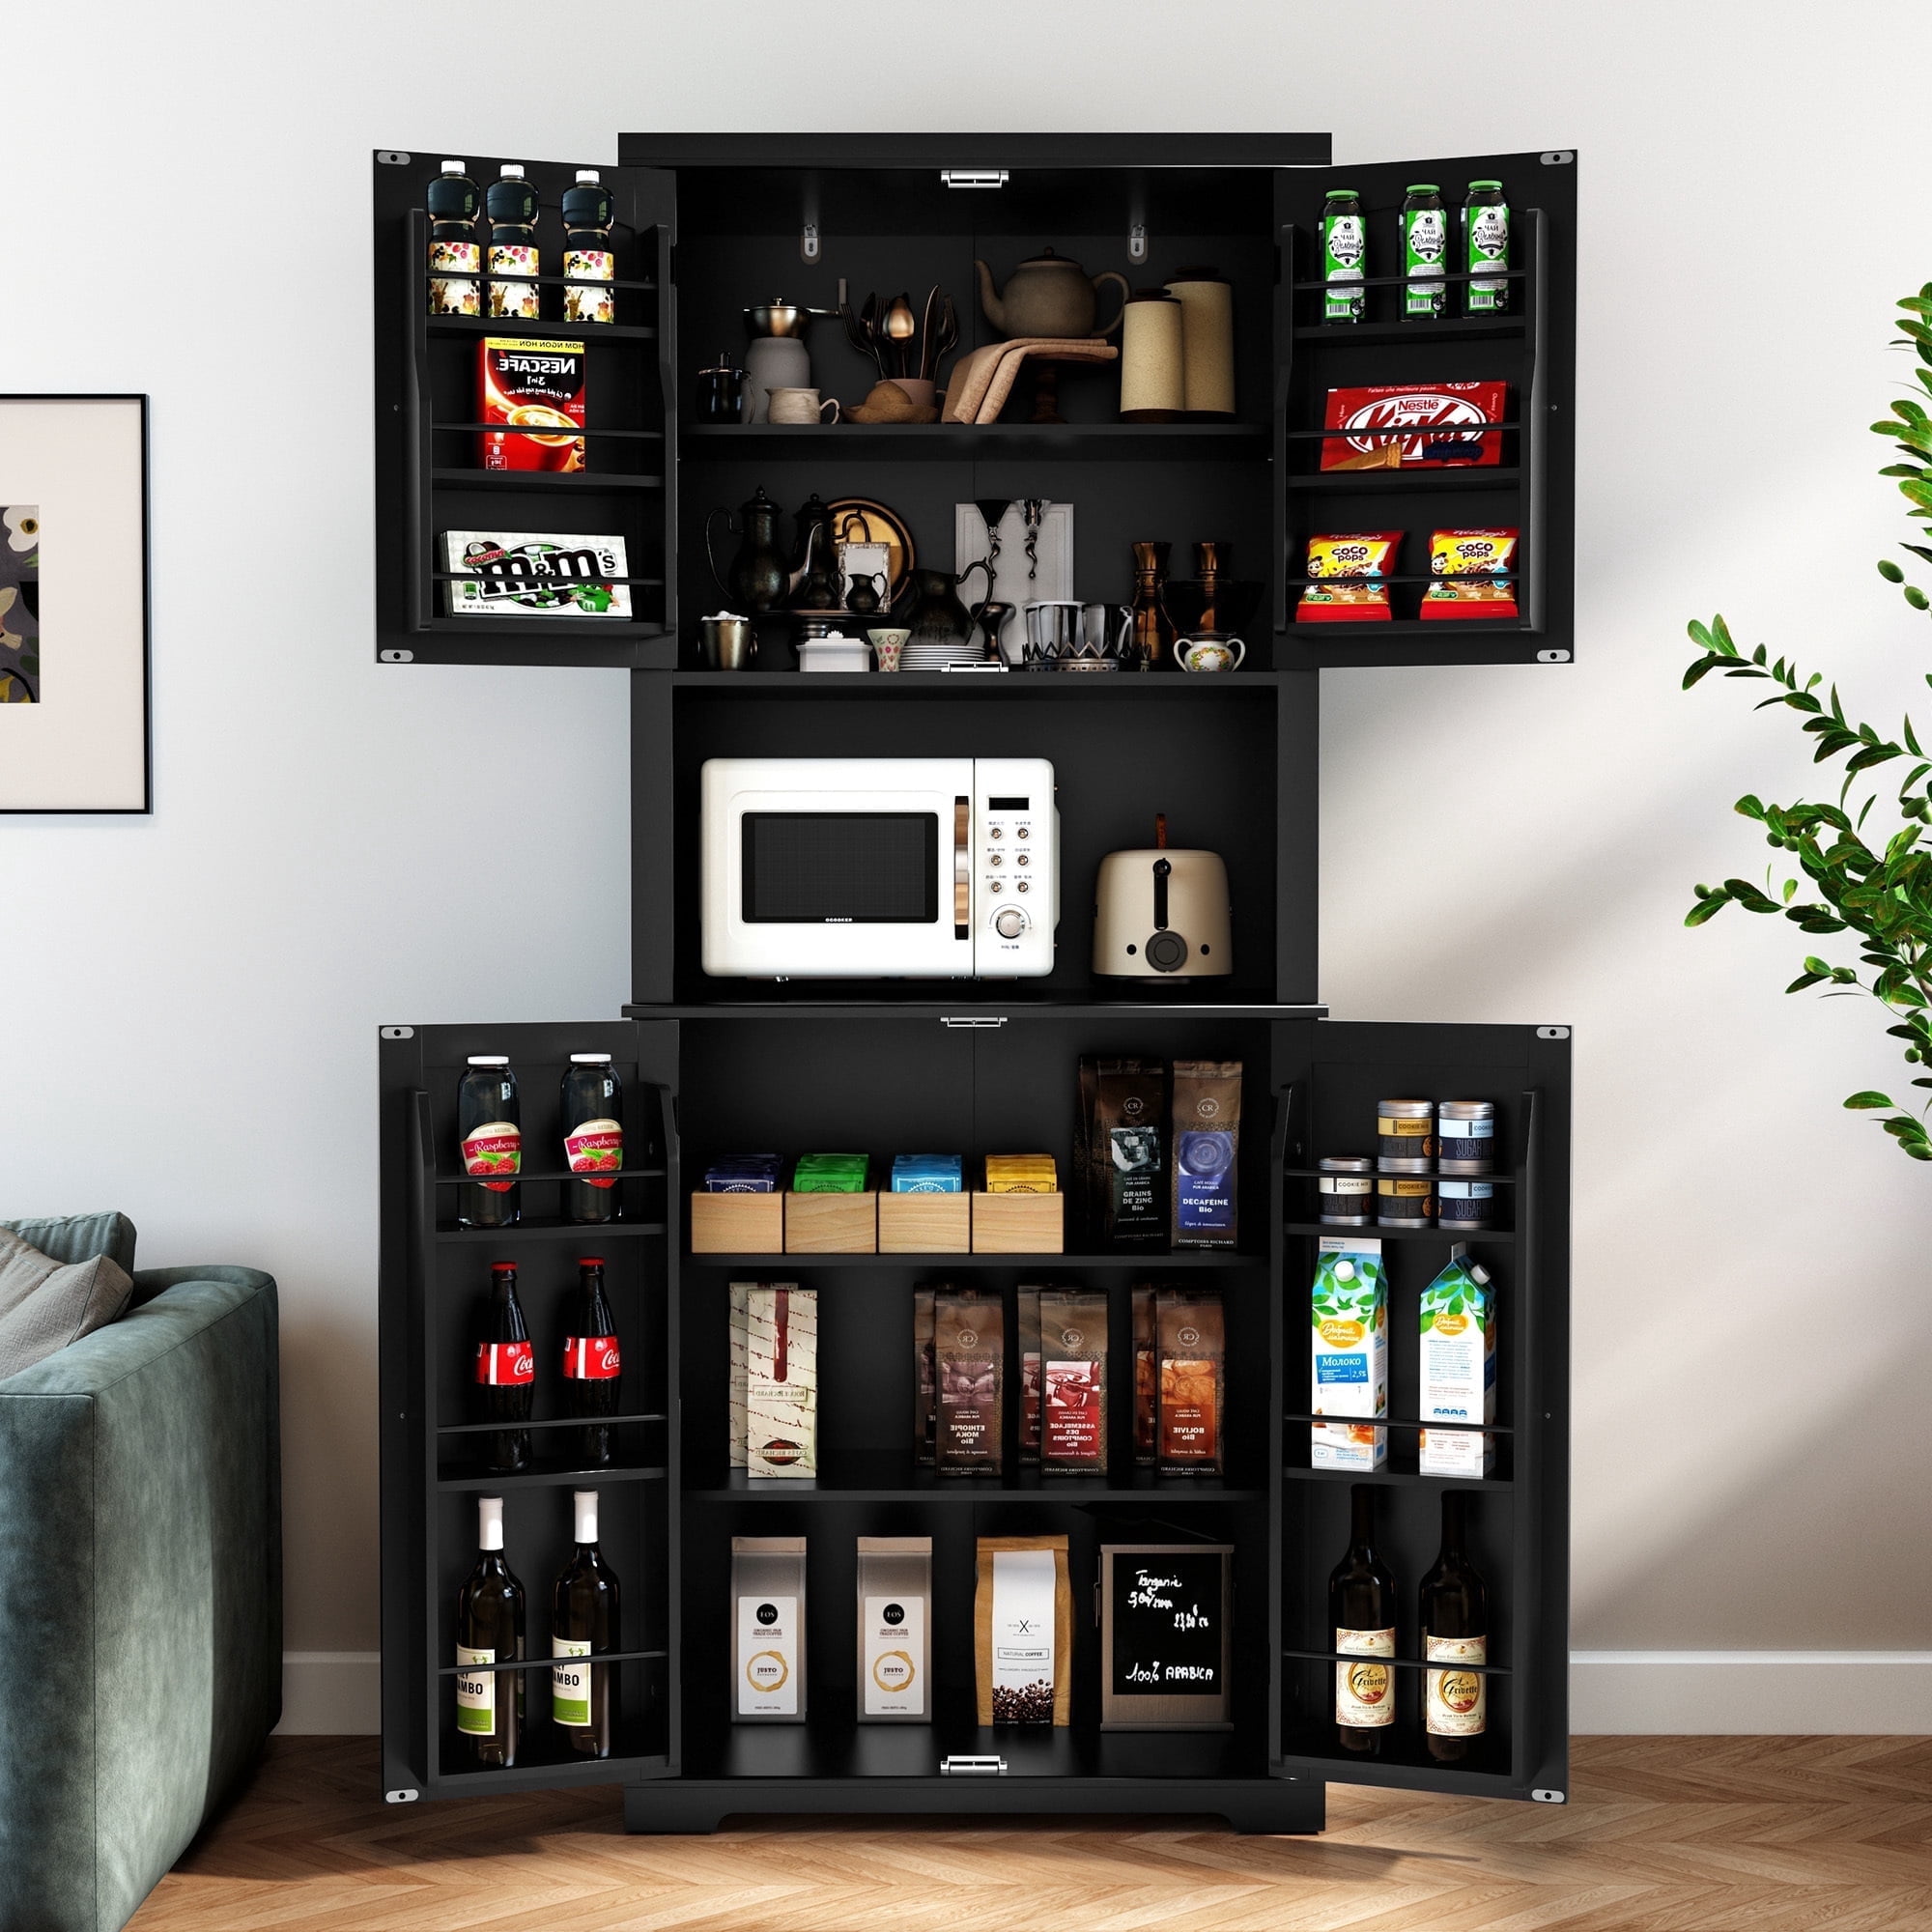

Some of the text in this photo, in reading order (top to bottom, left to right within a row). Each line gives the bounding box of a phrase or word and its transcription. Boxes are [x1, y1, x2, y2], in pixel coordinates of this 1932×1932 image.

[1456, 1139, 1482, 1157] SUGAR
[1455, 1199, 1482, 1217] SUGAR
[1322, 1357, 1362, 1367] Молоко
[1165, 1666, 1214, 1680] ARABICA
